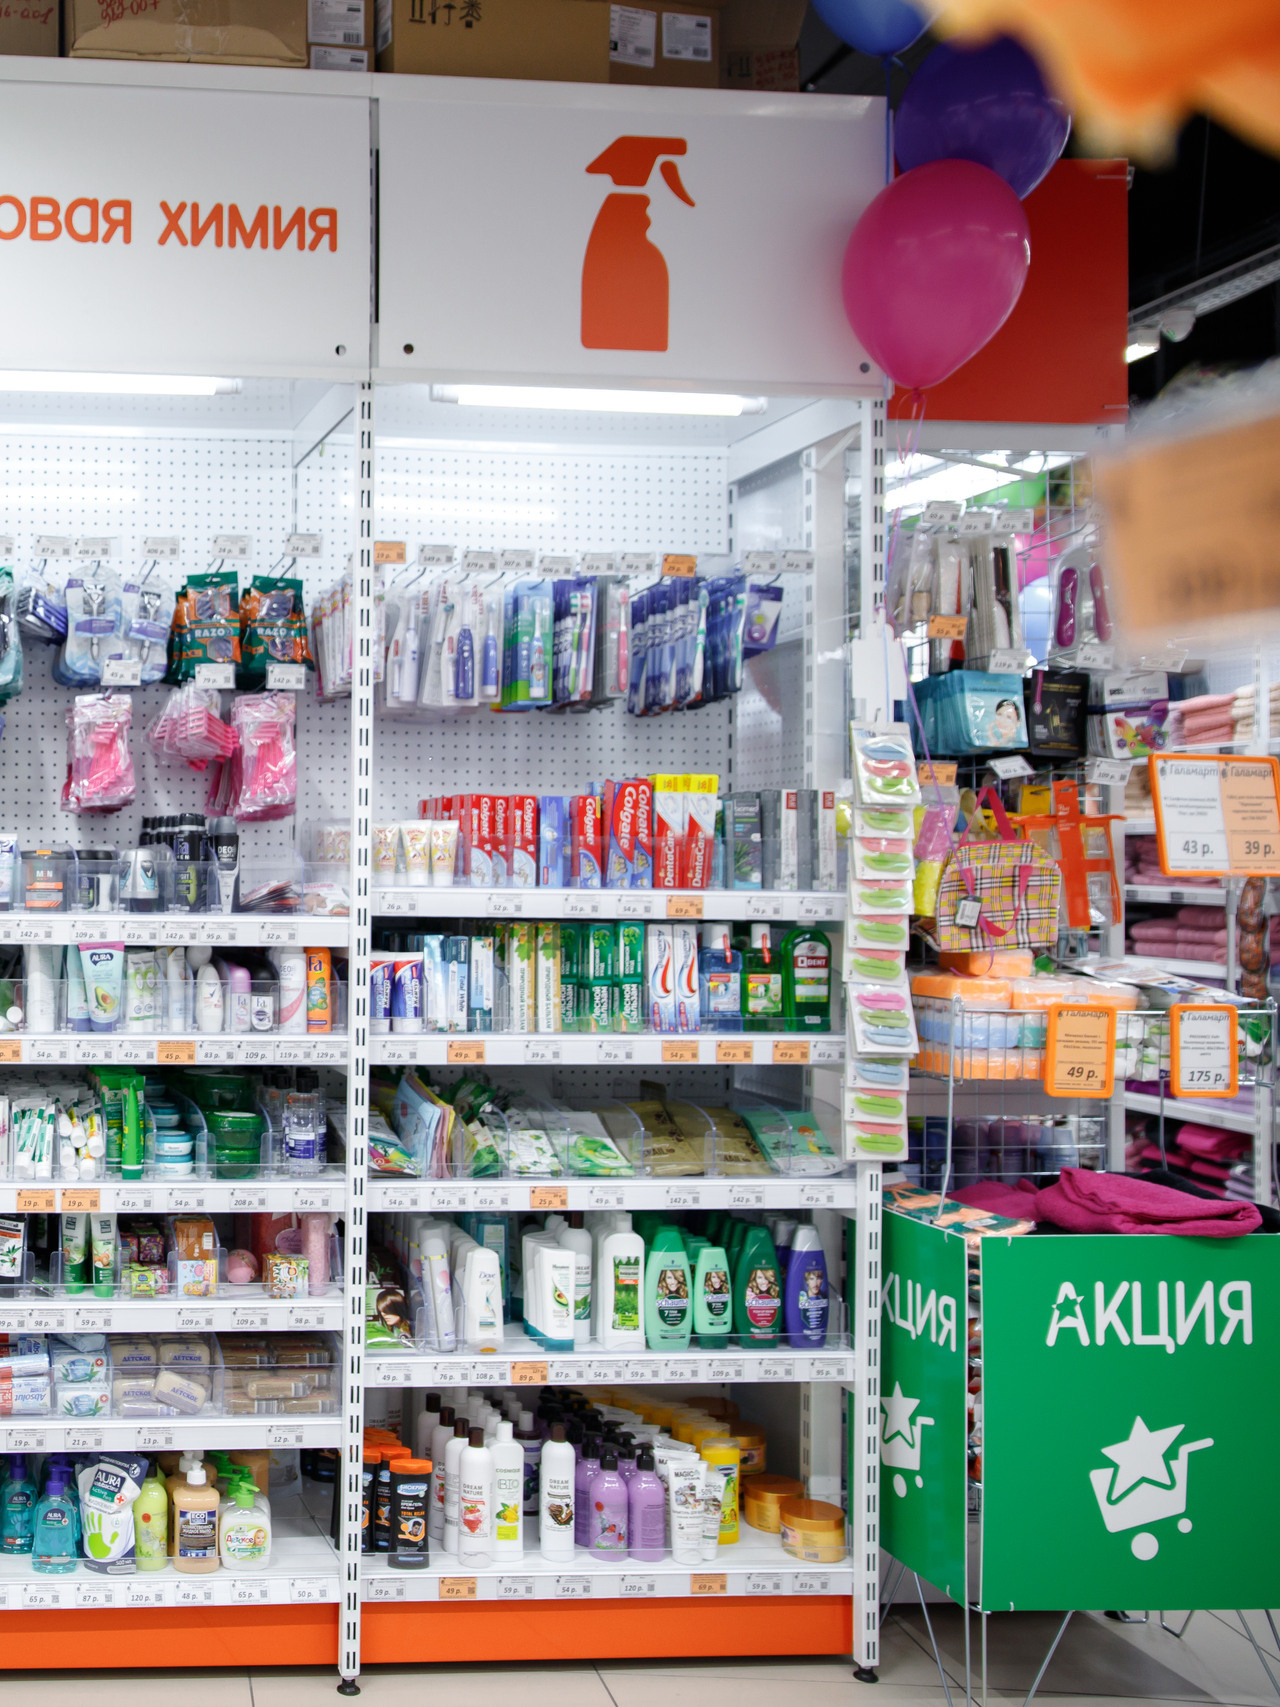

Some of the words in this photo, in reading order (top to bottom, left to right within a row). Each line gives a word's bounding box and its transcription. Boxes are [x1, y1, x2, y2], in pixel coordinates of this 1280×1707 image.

[157, 200, 339, 253] химия
[482, 797, 490, 838] Colgate
[524, 798, 533, 839] Colgate
[584, 797, 595, 845] Colgate
[620, 786, 637, 849] Colgate
[1183, 840, 1198, 854] 43
[1202, 843, 1214, 857] р.
[1244, 840, 1260, 854] 39
[1263, 844, 1275, 858] р.
[308, 955, 323, 972] Fa
[245, 1051, 260, 1059] 109
[1066, 1066, 1084, 1078] 49
[1086, 1070, 1099, 1081] р.
[1188, 1070, 1211, 1082] 175
[1213, 1073, 1226, 1084] р.
[181, 1318, 194, 1326] 109
[1045, 1280, 1253, 1354] АКЦИЯ
[476, 1372, 488, 1380] 108
[143, 1437, 152, 1445] 13
[95, 1469, 122, 1488] AURA
[445, 1587, 455, 1595] 49
[698, 1583, 707, 1591] 69
